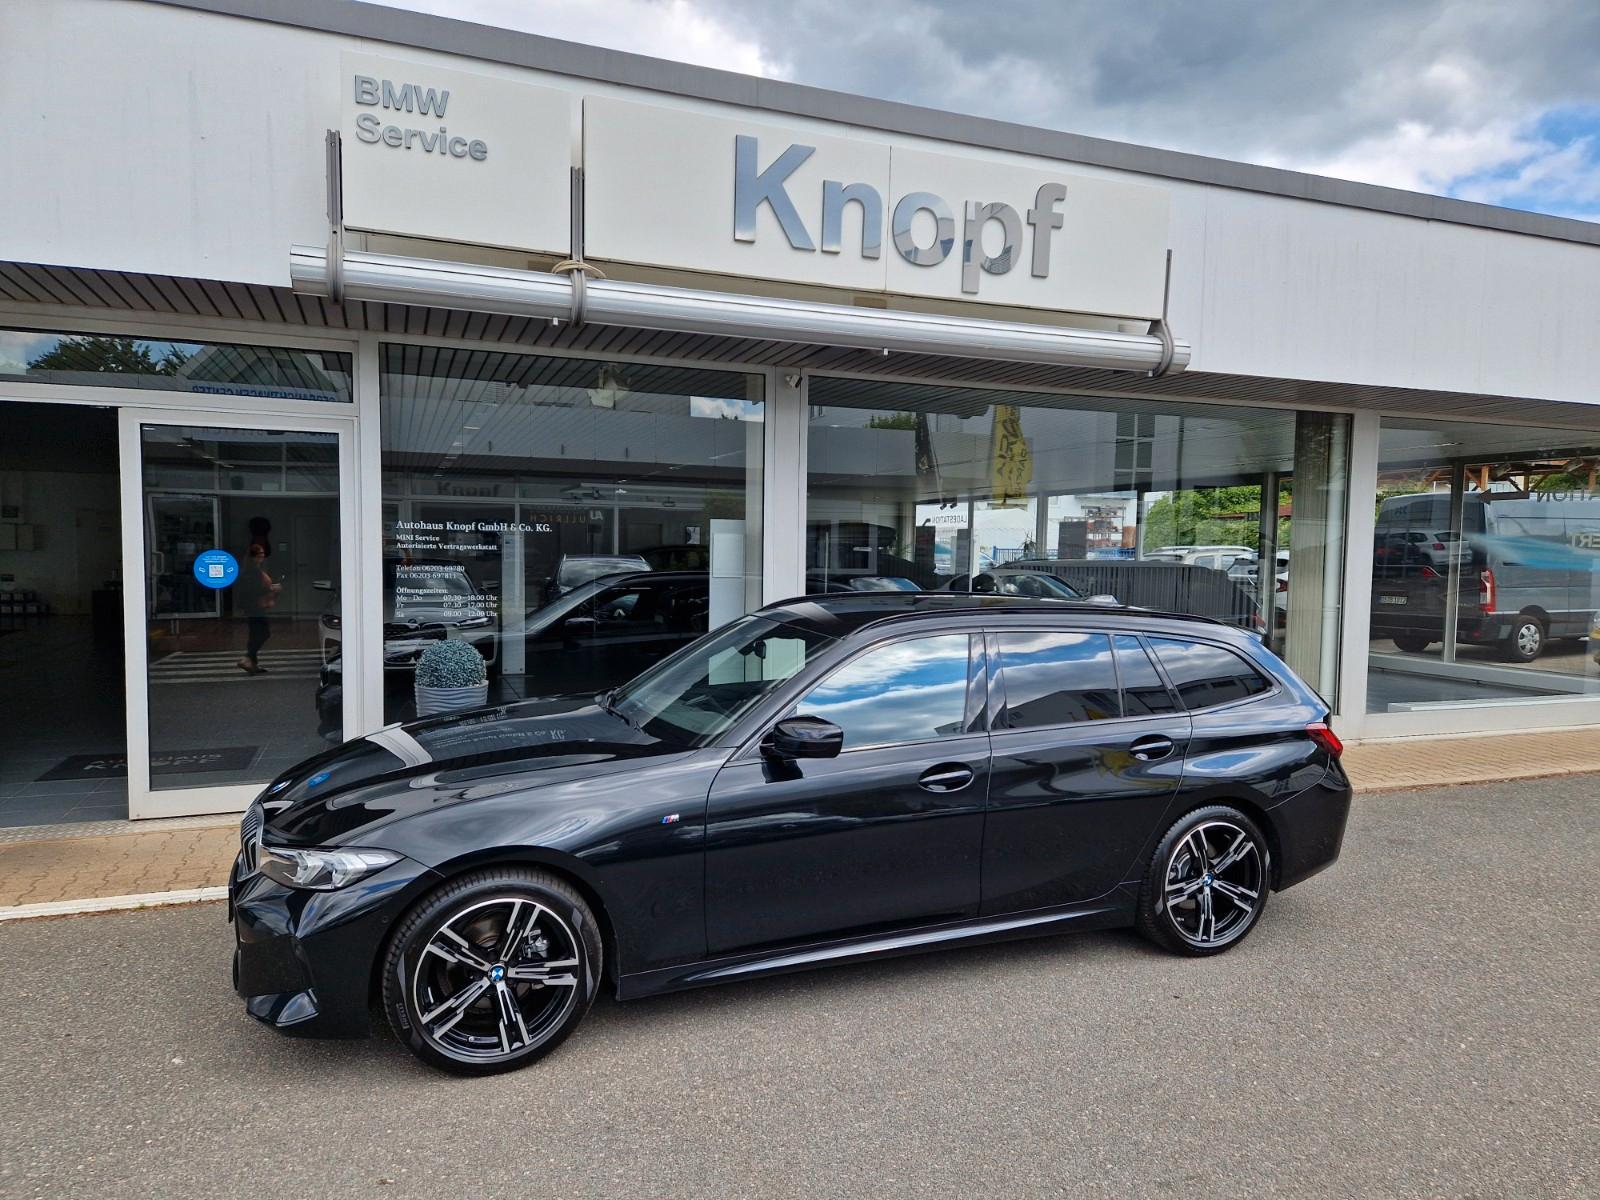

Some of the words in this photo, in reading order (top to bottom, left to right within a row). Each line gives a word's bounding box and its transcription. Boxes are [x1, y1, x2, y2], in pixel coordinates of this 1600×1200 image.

[355, 75, 450, 118] BMW
[356, 113, 488, 161] Service
[733, 134, 1068, 294] Knopf
[396, 520, 443, 530] Autohaus
[446, 521, 476, 532] Knopf
[478, 522, 507, 531] GmbH
[510, 523, 517, 531] &
[519, 523, 533, 532] Co.
[536, 523, 552, 532] KG.
[438, 543, 498, 551] Vertragswerkstatt
